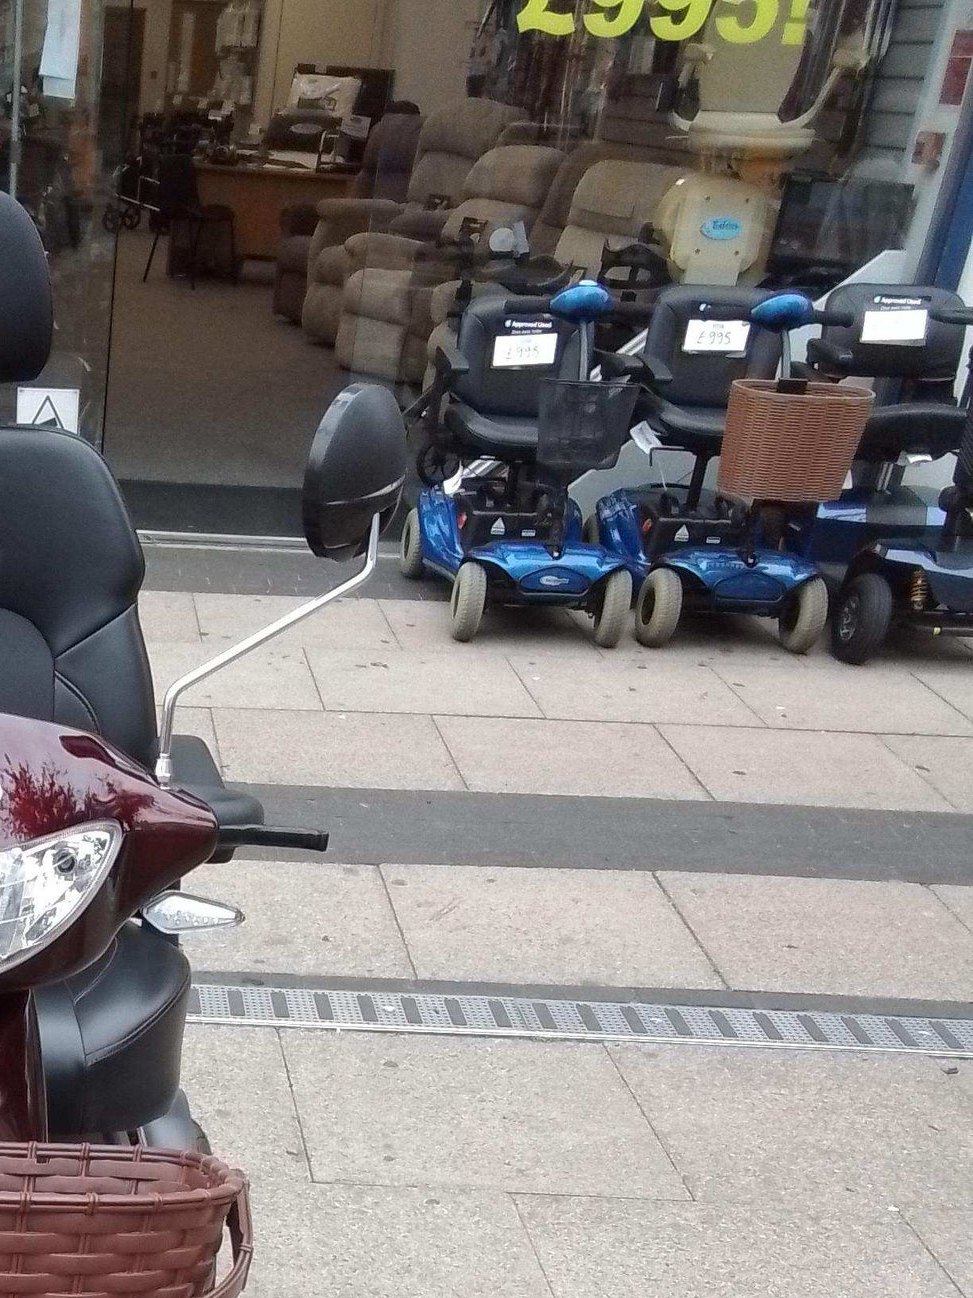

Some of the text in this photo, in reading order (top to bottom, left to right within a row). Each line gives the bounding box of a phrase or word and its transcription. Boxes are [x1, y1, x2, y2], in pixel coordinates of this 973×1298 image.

[511, 321, 553, 329] Approved Used
[697, 331, 732, 345] £995
